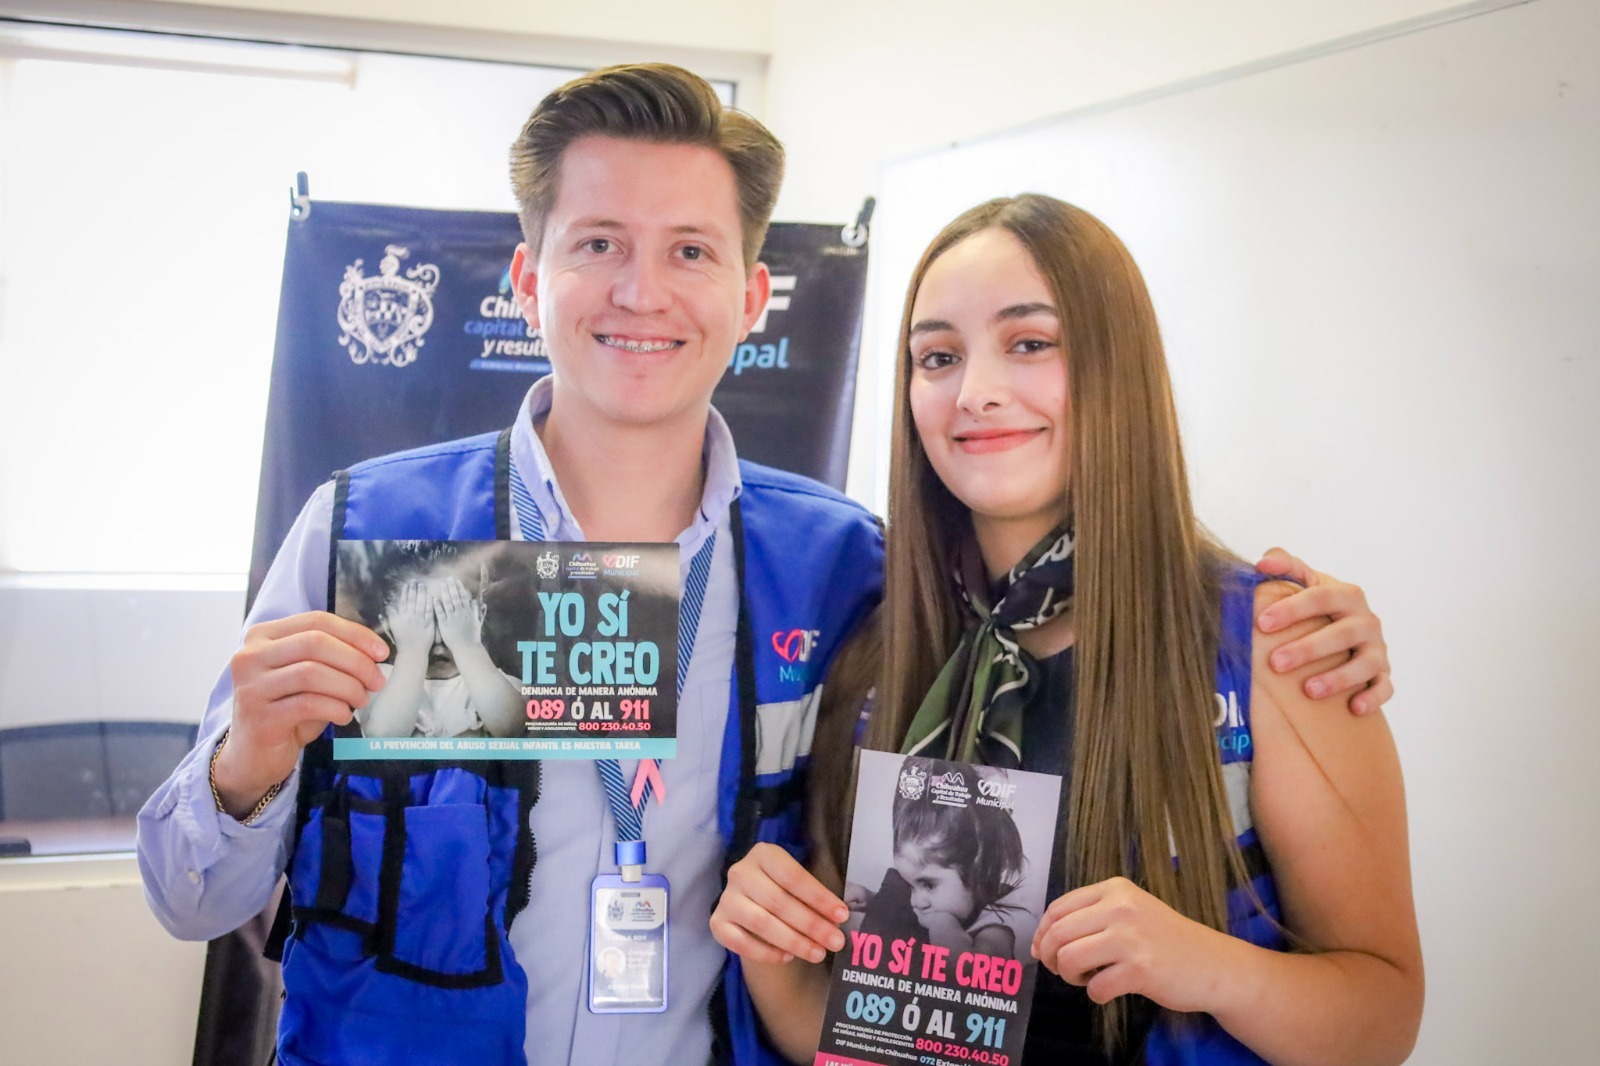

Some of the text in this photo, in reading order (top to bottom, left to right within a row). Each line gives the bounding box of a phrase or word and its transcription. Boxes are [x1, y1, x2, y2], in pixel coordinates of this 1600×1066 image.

[464, 319, 524, 338] capital
[480, 339, 496, 358] y
[615, 555, 640, 568] DIF
[603, 568, 640, 577] Municipal
[537, 589, 630, 637] YO SÍ
[517, 641, 660, 685] TE CREO
[521, 684, 658, 696] DENUNCIA DE MANERA ANÓNIMA
[526, 696, 650, 720] 089 Ó AL 911
[1213, 691, 1245, 727] DI
[578, 722, 651, 731] 800 230.40.50
[370, 739, 641, 750] LA PREVENCIÓN DEL ABUSO SEXUAL INFANTIL ES NUESTRA TAREA
[936, 782, 968, 793] Chihuahua
[990, 781, 1017, 799] DIF
[976, 797, 1014, 810] Municipal
[850, 930, 1023, 996] YO SÍ TE CREO
[842, 969, 1018, 1014] DENUNCIA DE MANERA ANÓNIMA
[845, 990, 1007, 1049] 089 Ó AL 911
[835, 1021, 874, 1034] PROCURADURÍA
[881, 1031, 913, 1042] PROTECCIÓN
[856, 1031, 873, 1040] NIÑOS
[877, 1036, 914, 1049] ADOLESCENTES
[846, 1040, 876, 1052] Municipal
[885, 1048, 918, 1061] Chihuahua
[920, 1055, 936, 1066] 072
[915, 1037, 1009, 1066] 800 230.40.50
